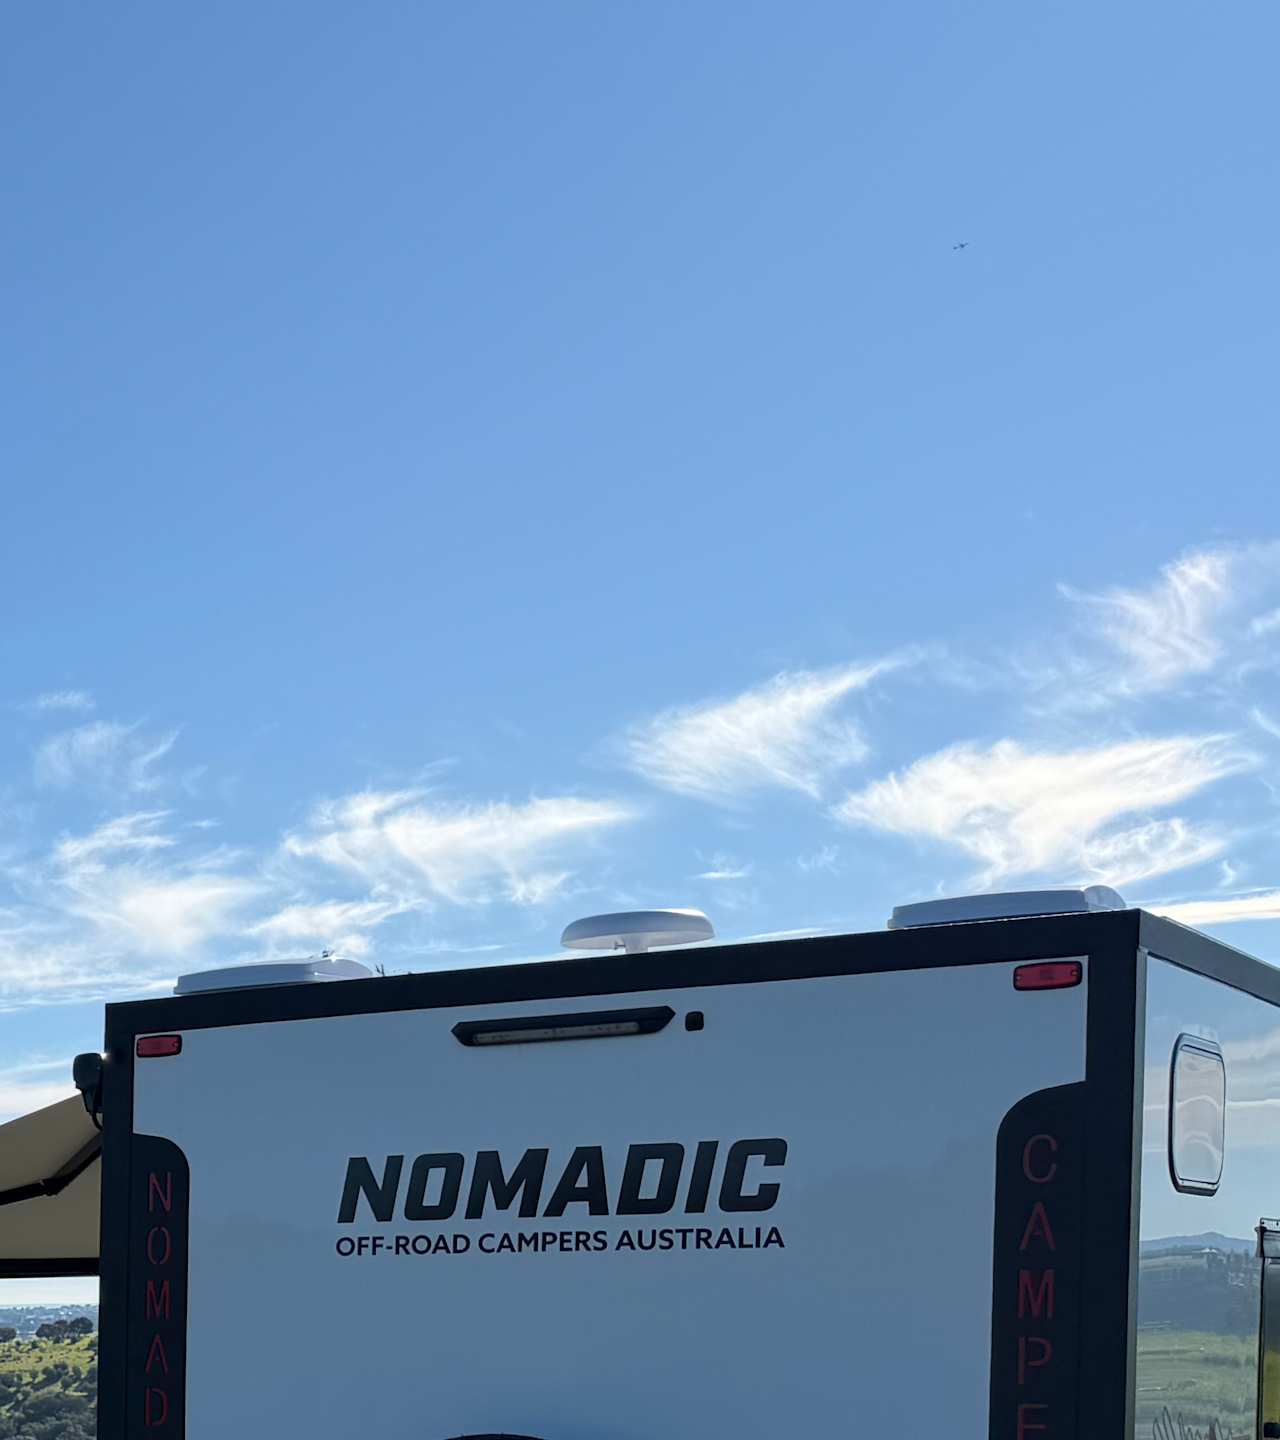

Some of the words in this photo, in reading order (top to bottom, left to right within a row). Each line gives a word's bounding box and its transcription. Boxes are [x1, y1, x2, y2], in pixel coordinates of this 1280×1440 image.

[337, 1138, 788, 1223] NOMADIC
[335, 1233, 471, 1257] OFF-ROAD
[478, 1230, 609, 1254] CAMPERS
[615, 1226, 786, 1251] AUSTRALIA
